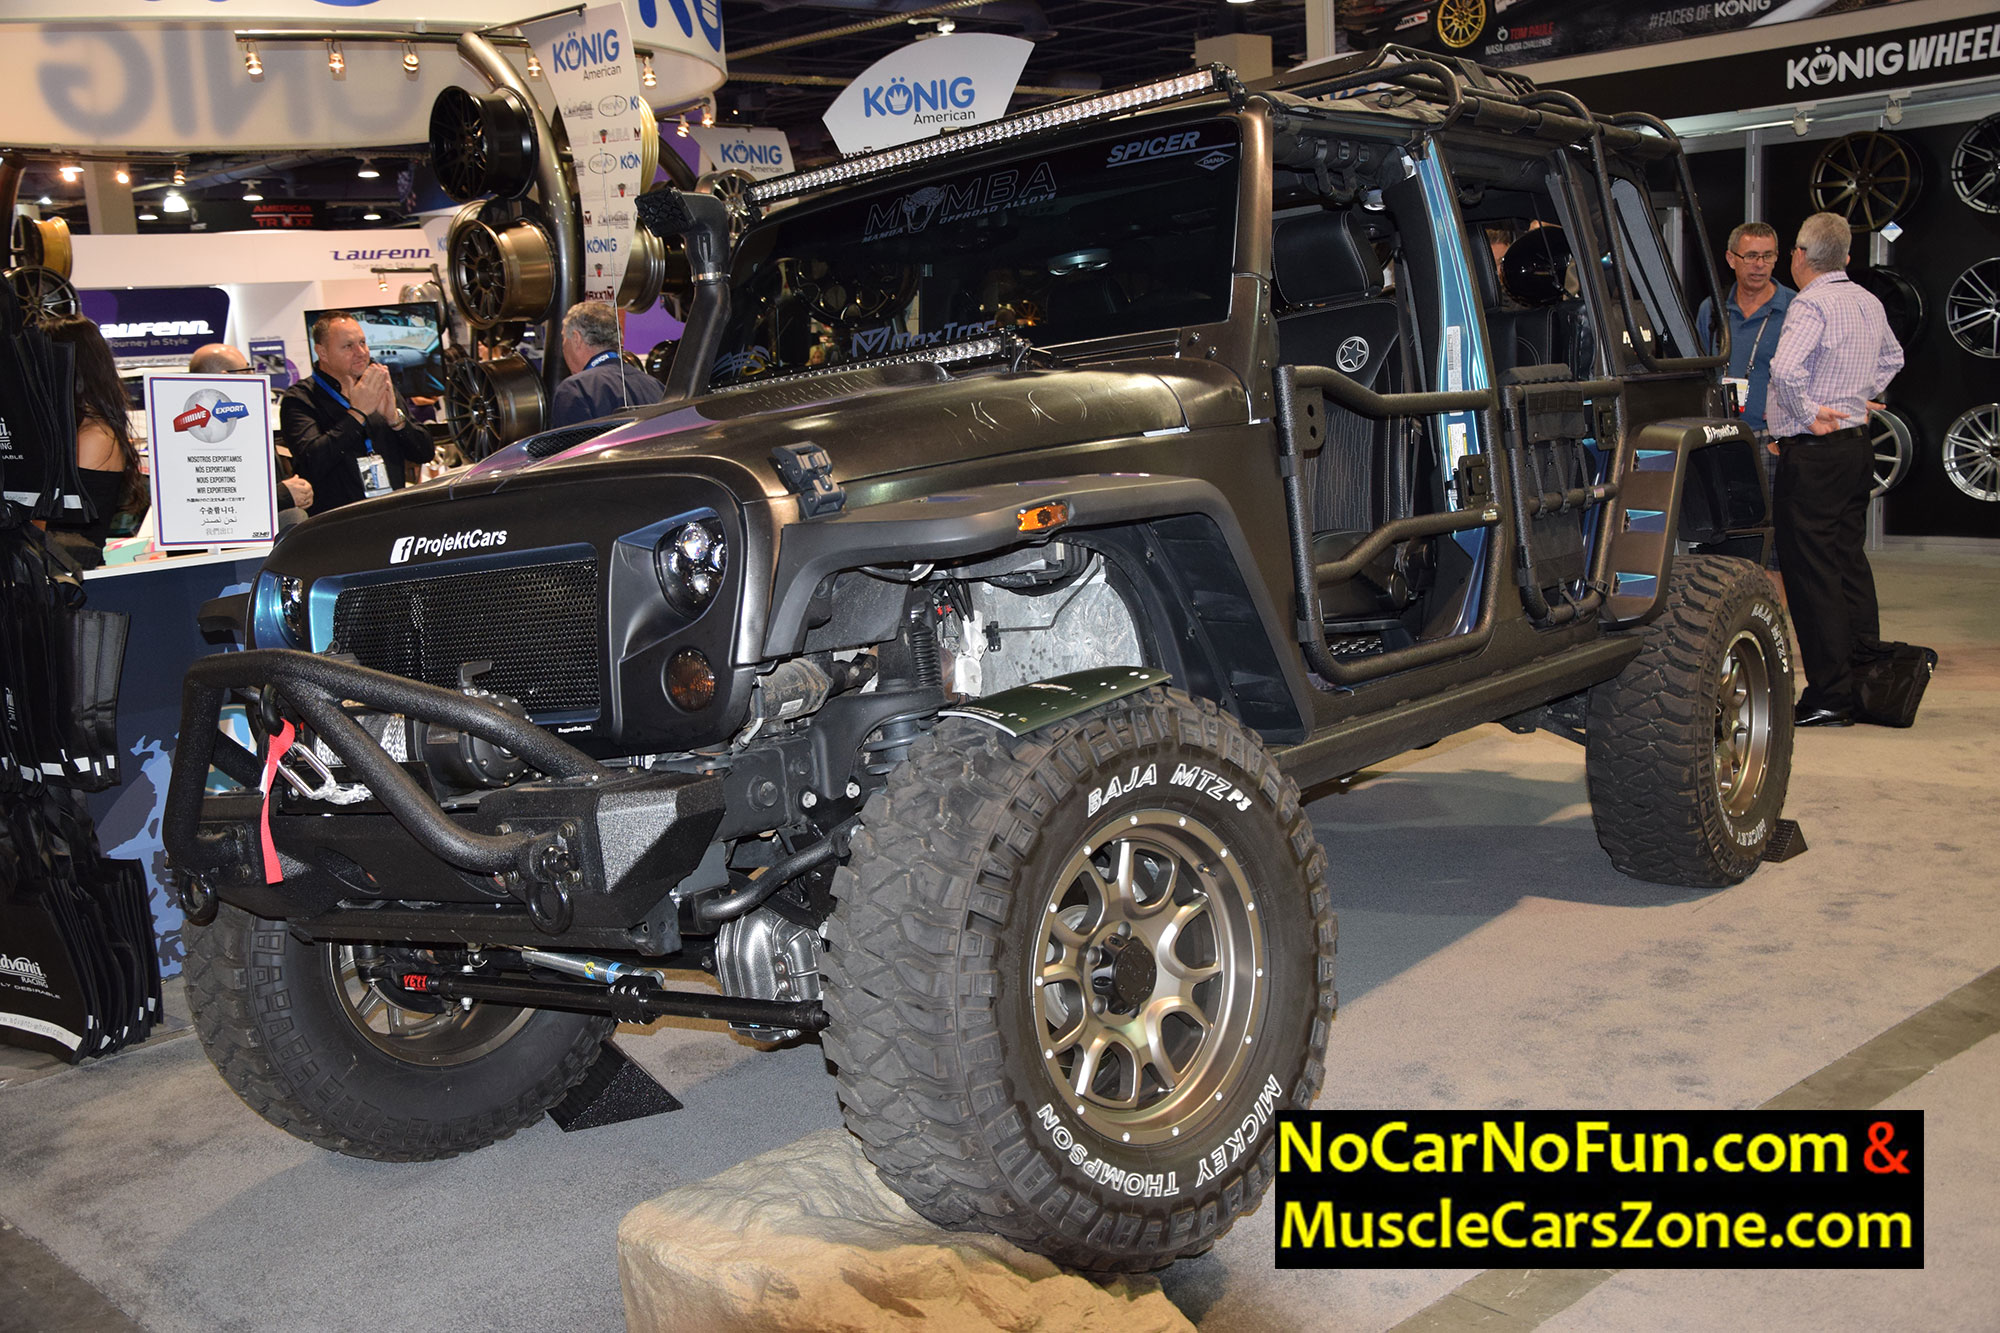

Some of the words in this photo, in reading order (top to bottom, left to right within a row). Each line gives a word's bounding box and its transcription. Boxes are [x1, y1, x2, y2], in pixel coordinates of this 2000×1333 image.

[1696, 4, 1712, 21] OF
[552, 29, 620, 74] KÖNIG
[583, 65, 622, 81] American
[1787, 42, 1904, 90] KÖNIG
[863, 76, 975, 118] KÖNIG
[913, 110, 976, 125] American
[720, 140, 783, 165] KÖNIG
[1107, 131, 1200, 163] SPICER
[750, 165, 784, 173] American
[1203, 157, 1225, 165] DANA
[938, 204, 999, 226] OFFROAD
[1002, 192, 1057, 210] ALLOYS
[586, 237, 617, 254] KÖNIG
[162, 337, 189, 347] Style
[215, 405, 244, 414] EXPORT
[212, 455, 242, 463] EXPORTAMOS
[205, 465, 236, 473] EXPORTAMOS
[196, 476, 209, 484] NOUS
[413, 528, 508, 557] ProjektCars
[1088, 763, 1157, 818] BAJA
[403, 974, 428, 988] YETI
[1195, 1074, 1283, 1188] MICKEY
[1036, 1103, 1180, 1198] THOMPSON
